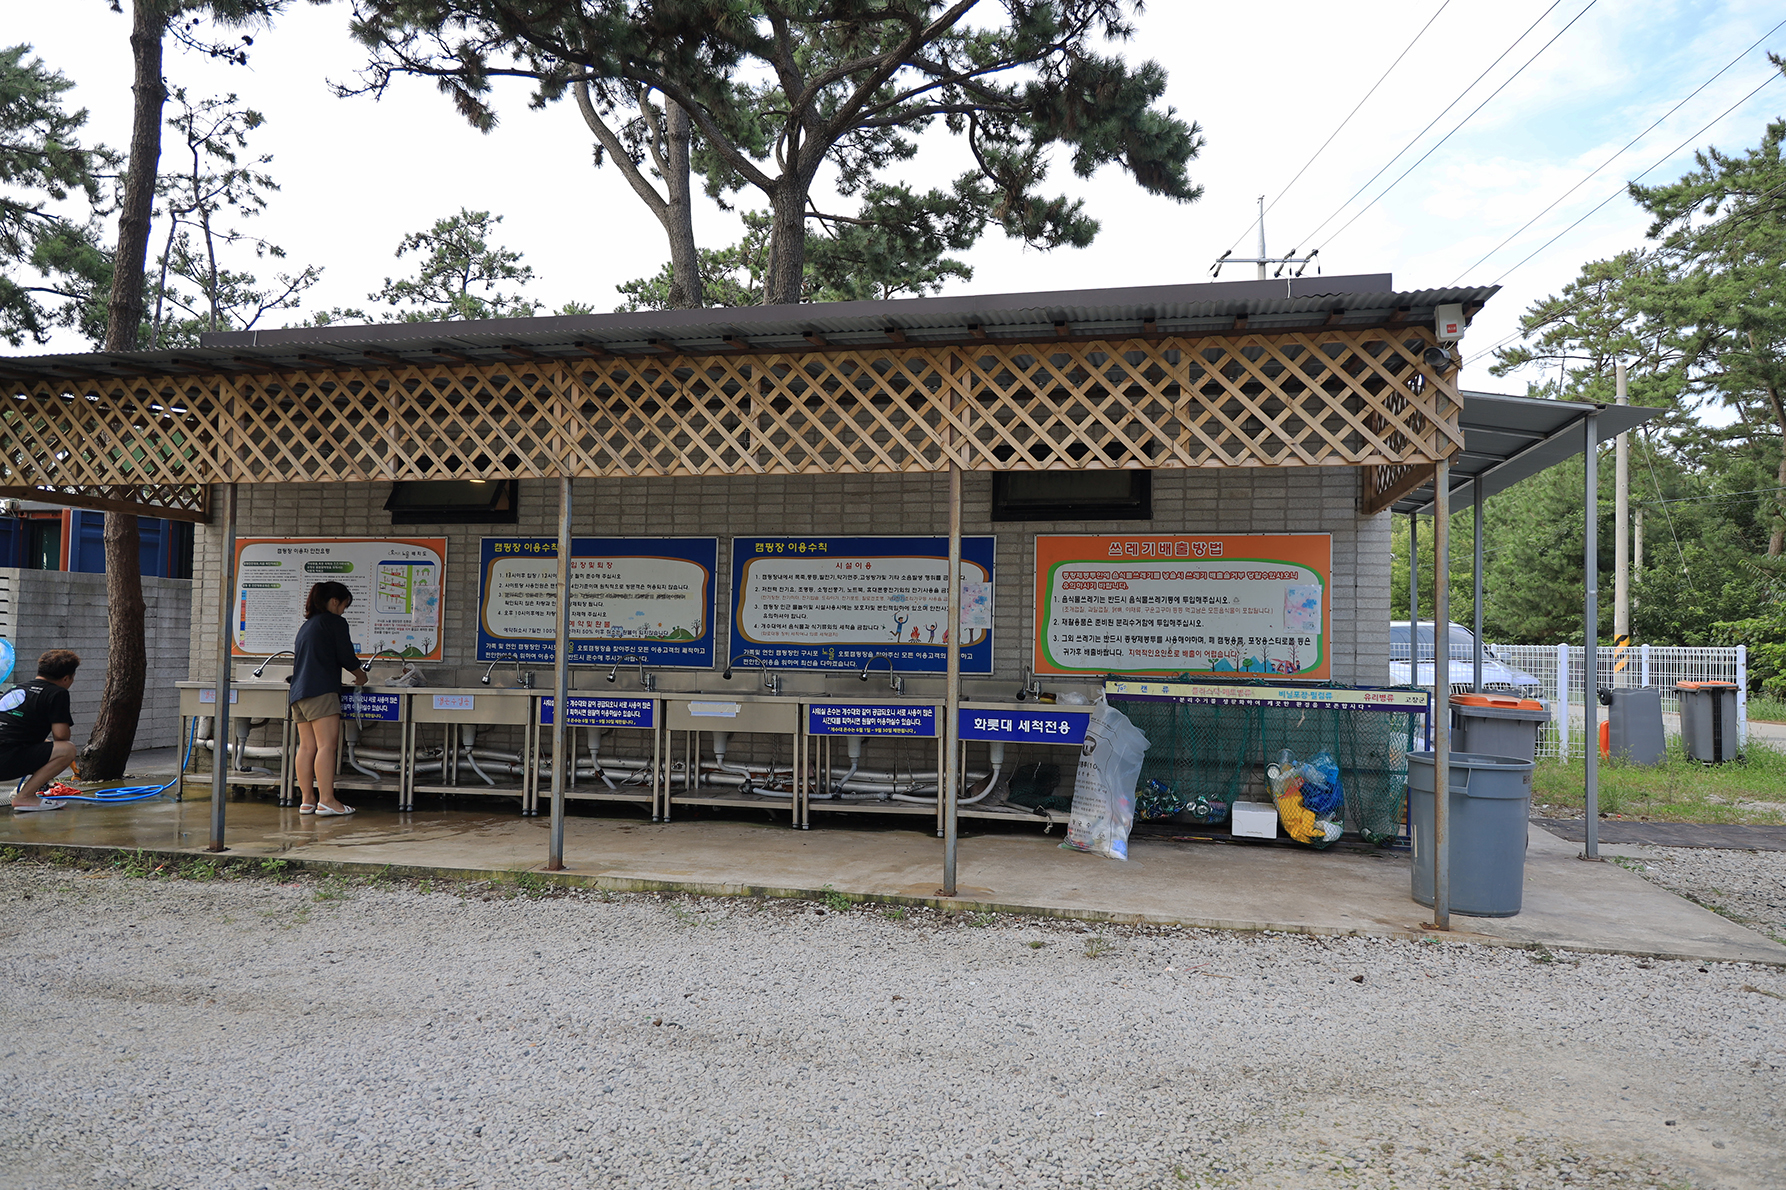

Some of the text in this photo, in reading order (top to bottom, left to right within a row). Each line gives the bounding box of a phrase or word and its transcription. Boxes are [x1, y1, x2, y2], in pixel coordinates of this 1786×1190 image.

[494, 543, 522, 552] 캠핑장
[755, 543, 828, 552] 캠핑장 이용수칙
[1185, 571, 1208, 579] 쓰레기
[1062, 582, 1129, 590] 유의하시기 바랍니다.
[1183, 596, 1231, 604] 투입해주십시오.
[1104, 635, 1123, 643] 반드시
[822, 647, 835, 661] 노을
[1129, 649, 1180, 657] 지역적인요인으로
[1364, 693, 1395, 703] 유리병류
[1267, 700, 1290, 708] 깨끗한
[1296, 700, 1318, 709] 환경을
[974, 719, 1071, 733] 화롯대 세척전용
